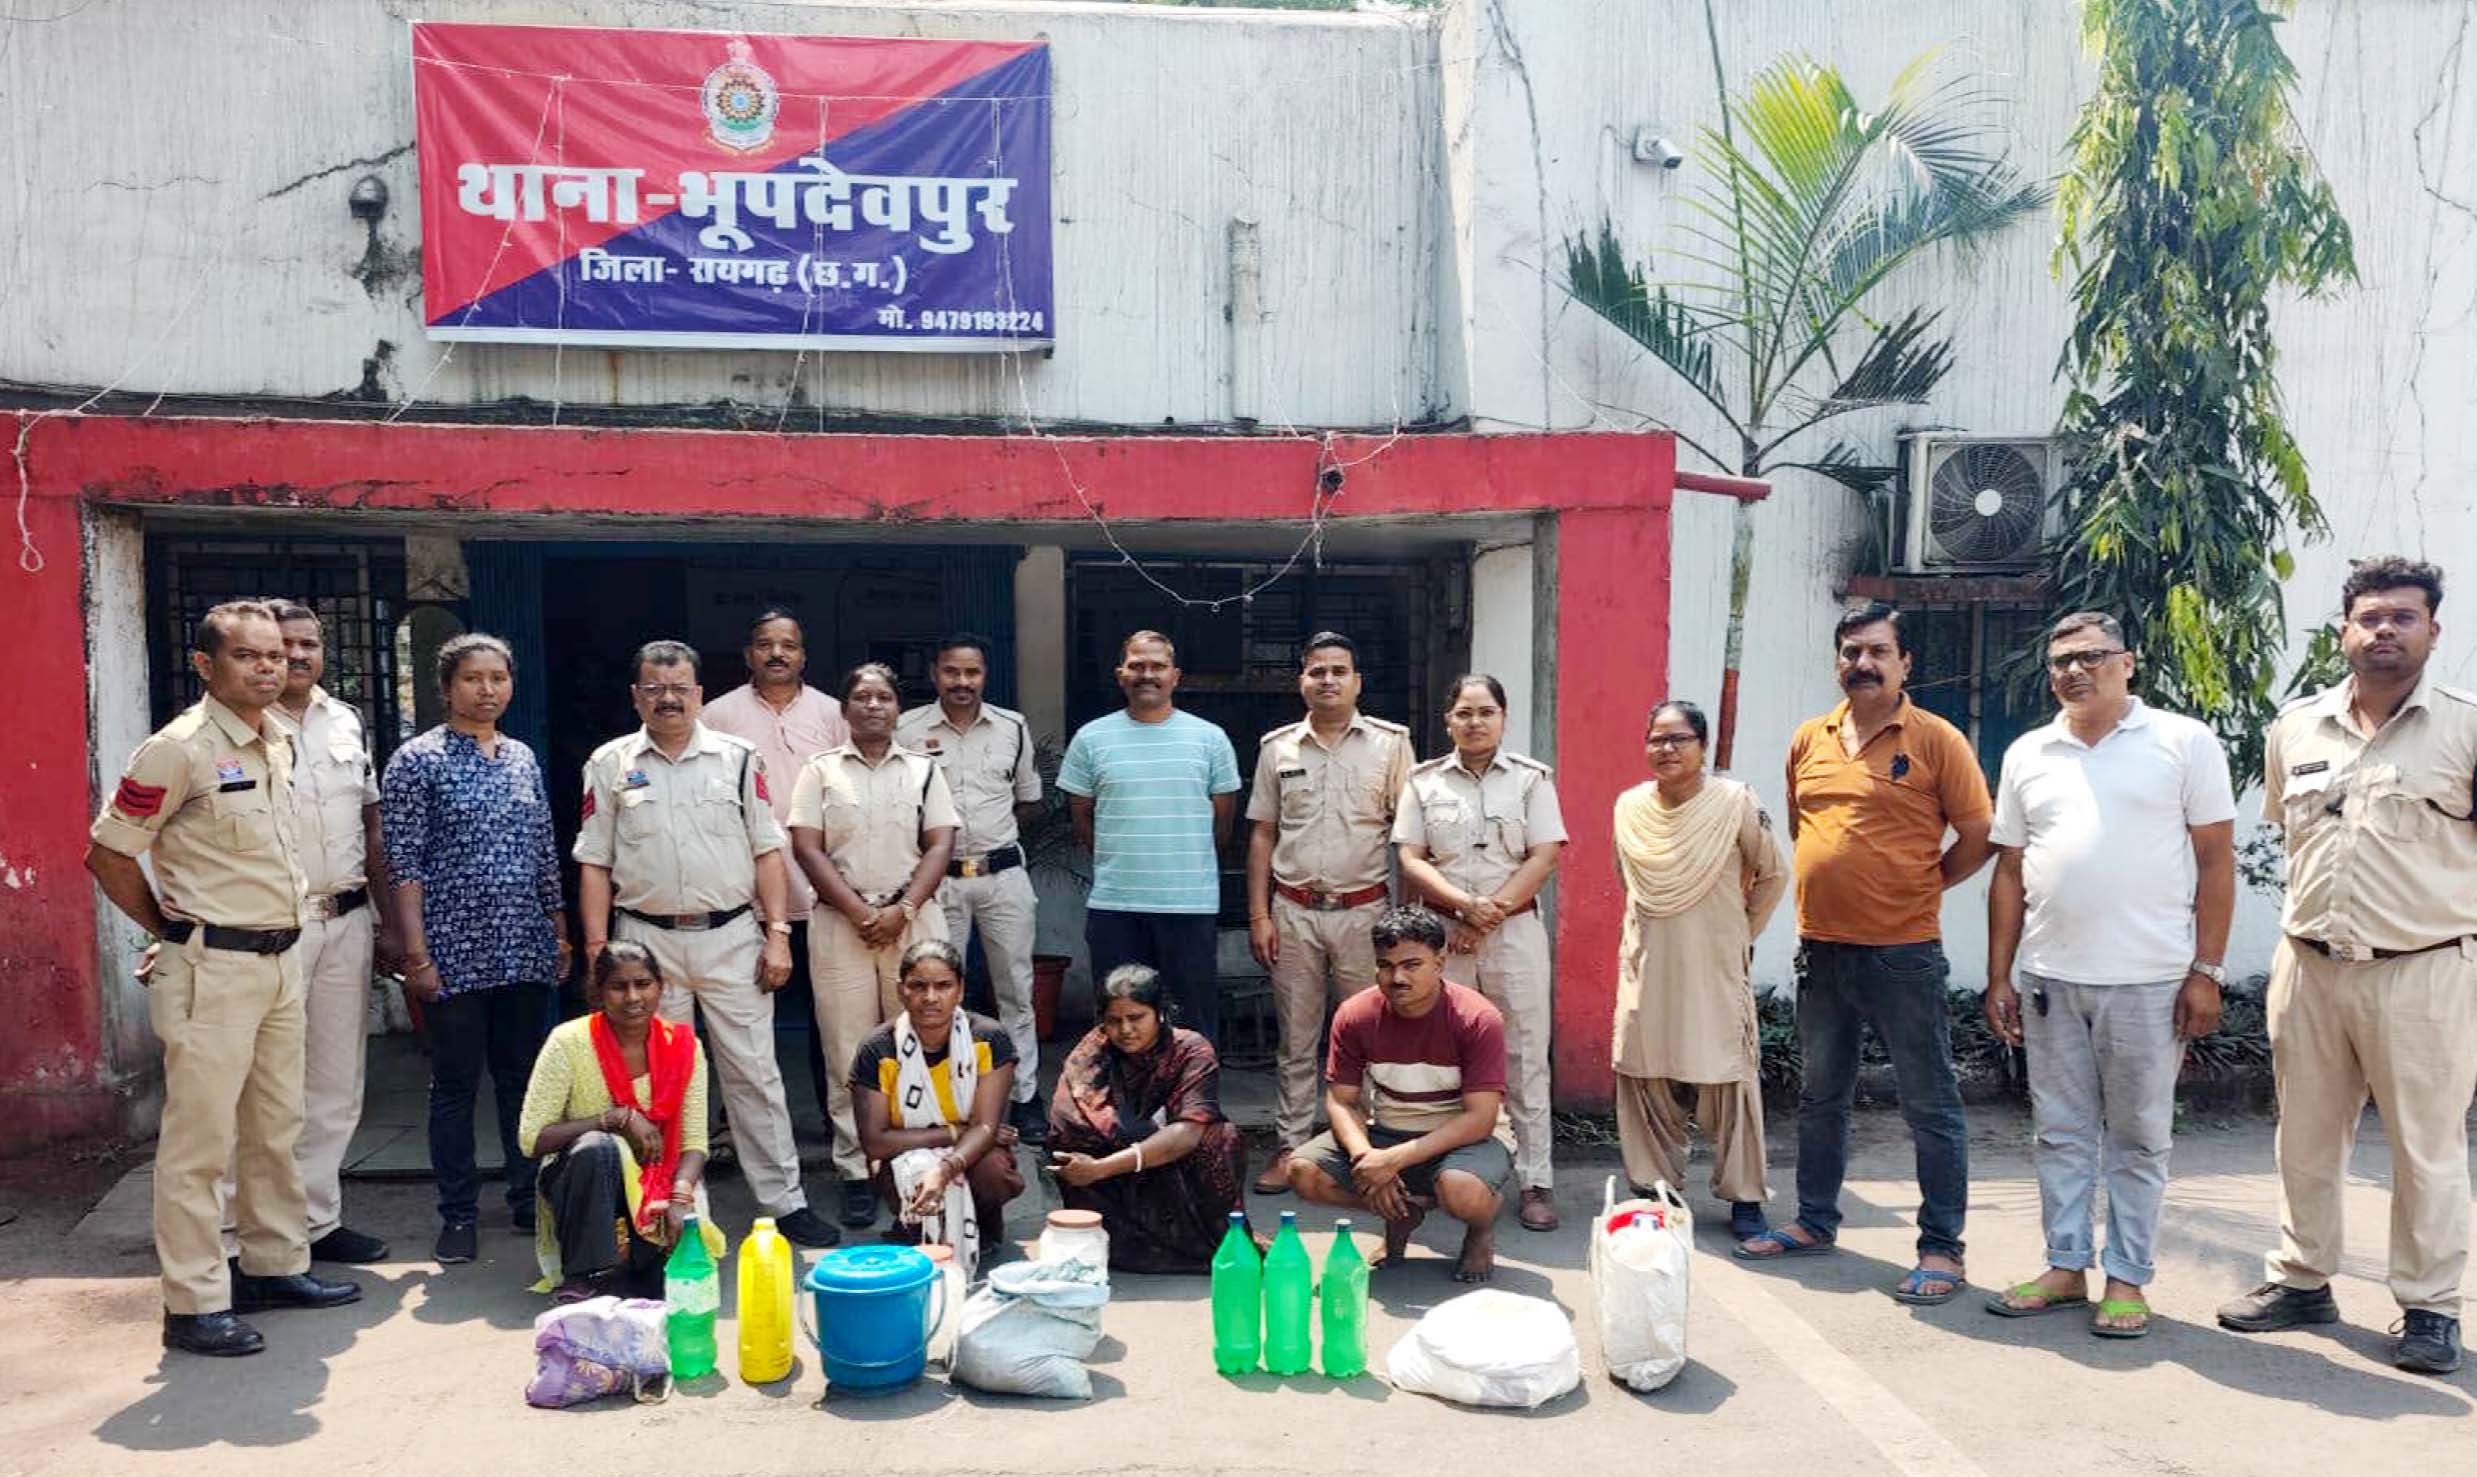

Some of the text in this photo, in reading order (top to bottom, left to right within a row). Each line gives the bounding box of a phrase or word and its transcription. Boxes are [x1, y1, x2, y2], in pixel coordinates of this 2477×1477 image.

[578, 246, 908, 298] जिला- रायगढ़ (छ.ग.)
[876, 303, 913, 330] मो.
